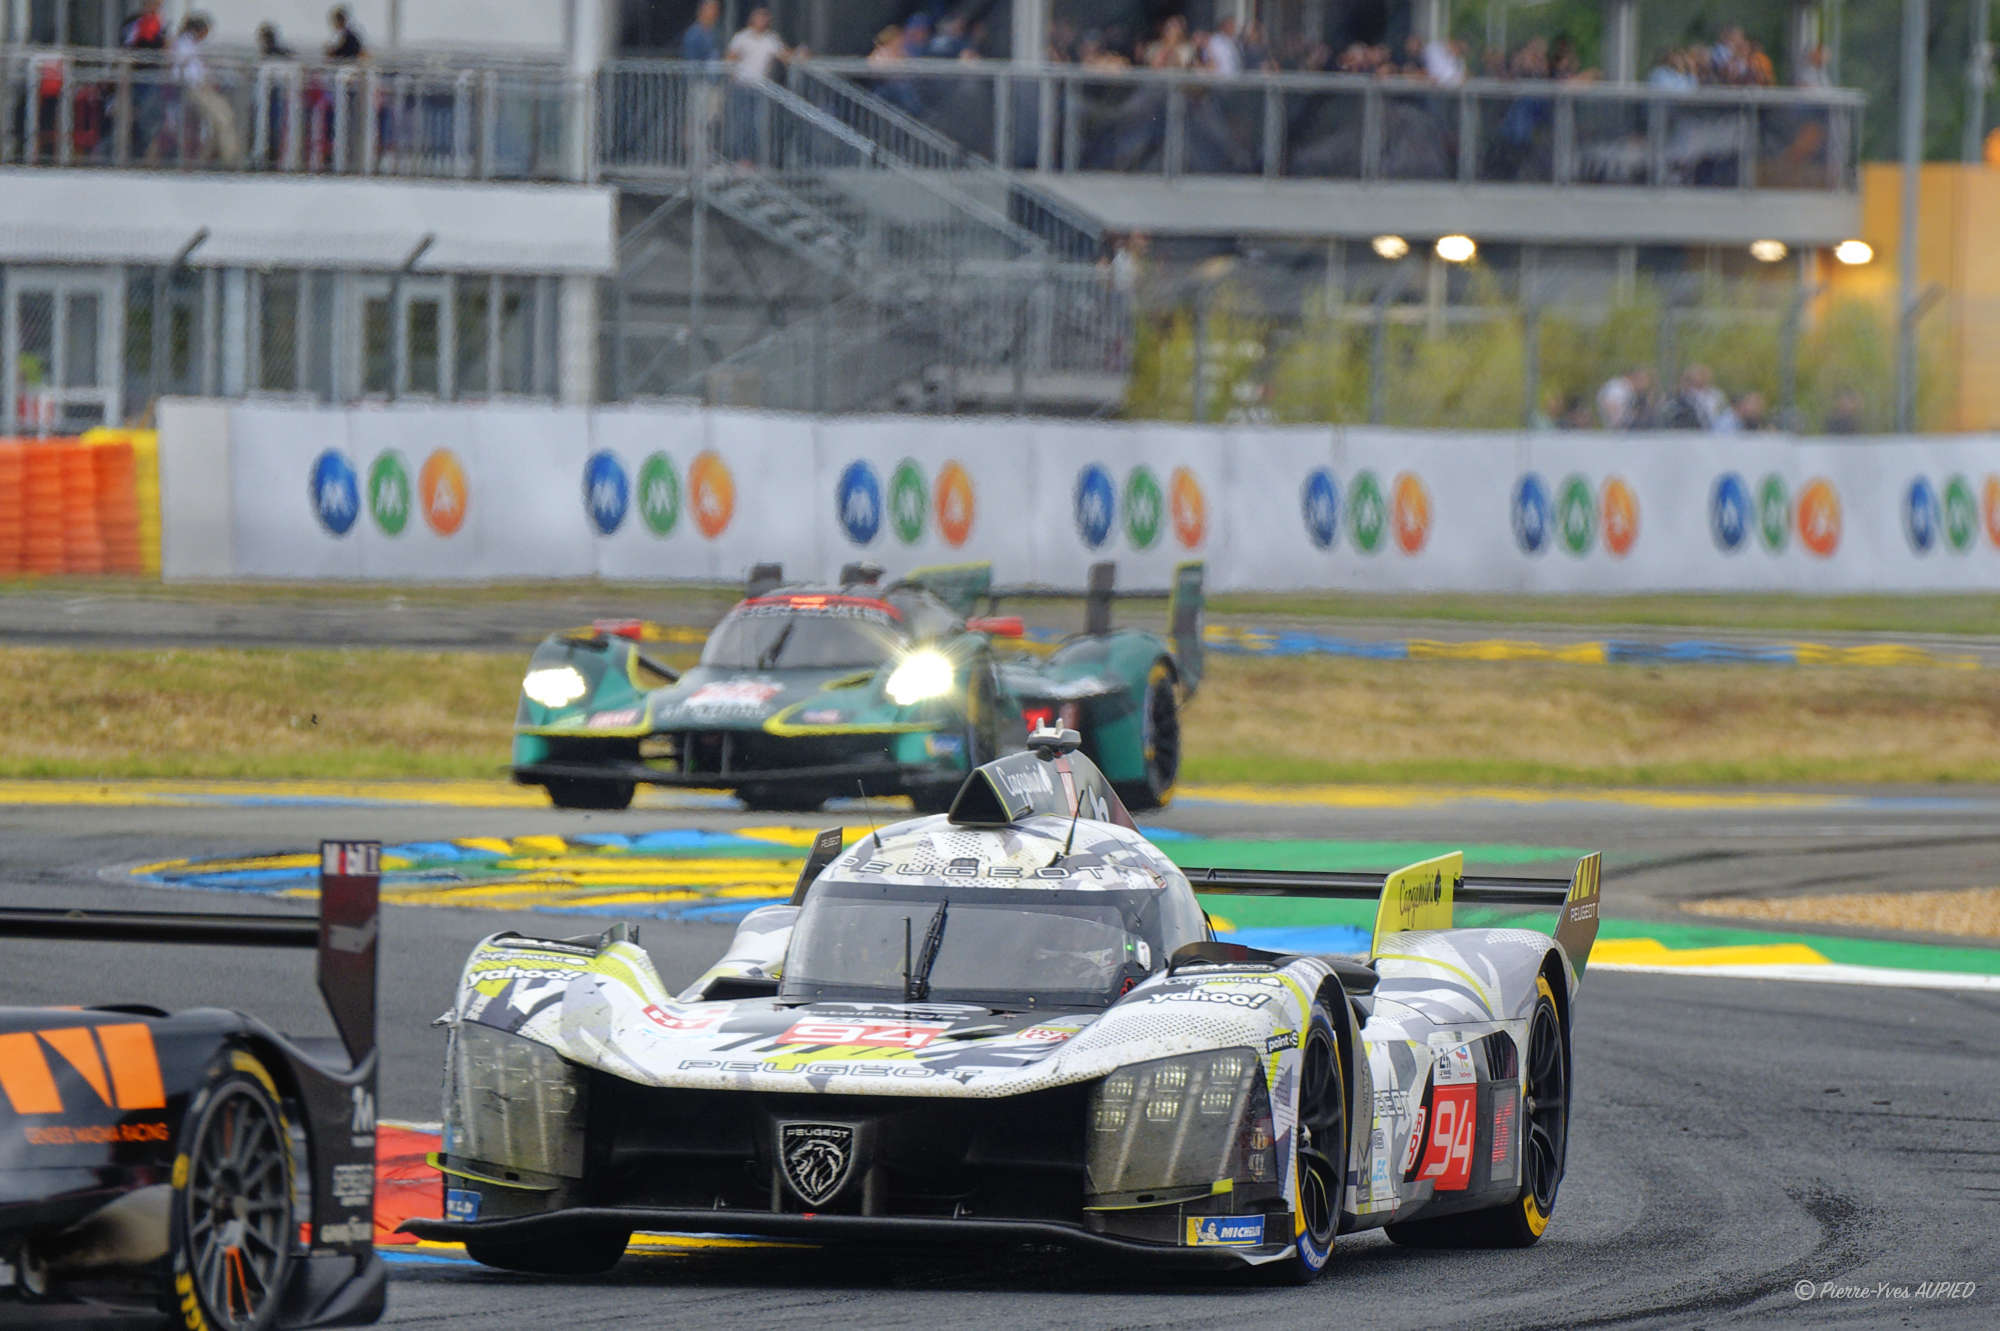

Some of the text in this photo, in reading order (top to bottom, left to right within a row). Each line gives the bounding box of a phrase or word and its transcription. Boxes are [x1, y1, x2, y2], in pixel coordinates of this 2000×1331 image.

[839, 855, 1106, 881] PEUGEOT
[466, 966, 584, 990] yahoo!
[1149, 988, 1273, 1010] yahoo!
[786, 1025, 930, 1047] 94
[677, 1058, 983, 1082] PEUGEOT
[786, 1128, 849, 1138] PEUGEOT
[1424, 1099, 1473, 1175] 94
